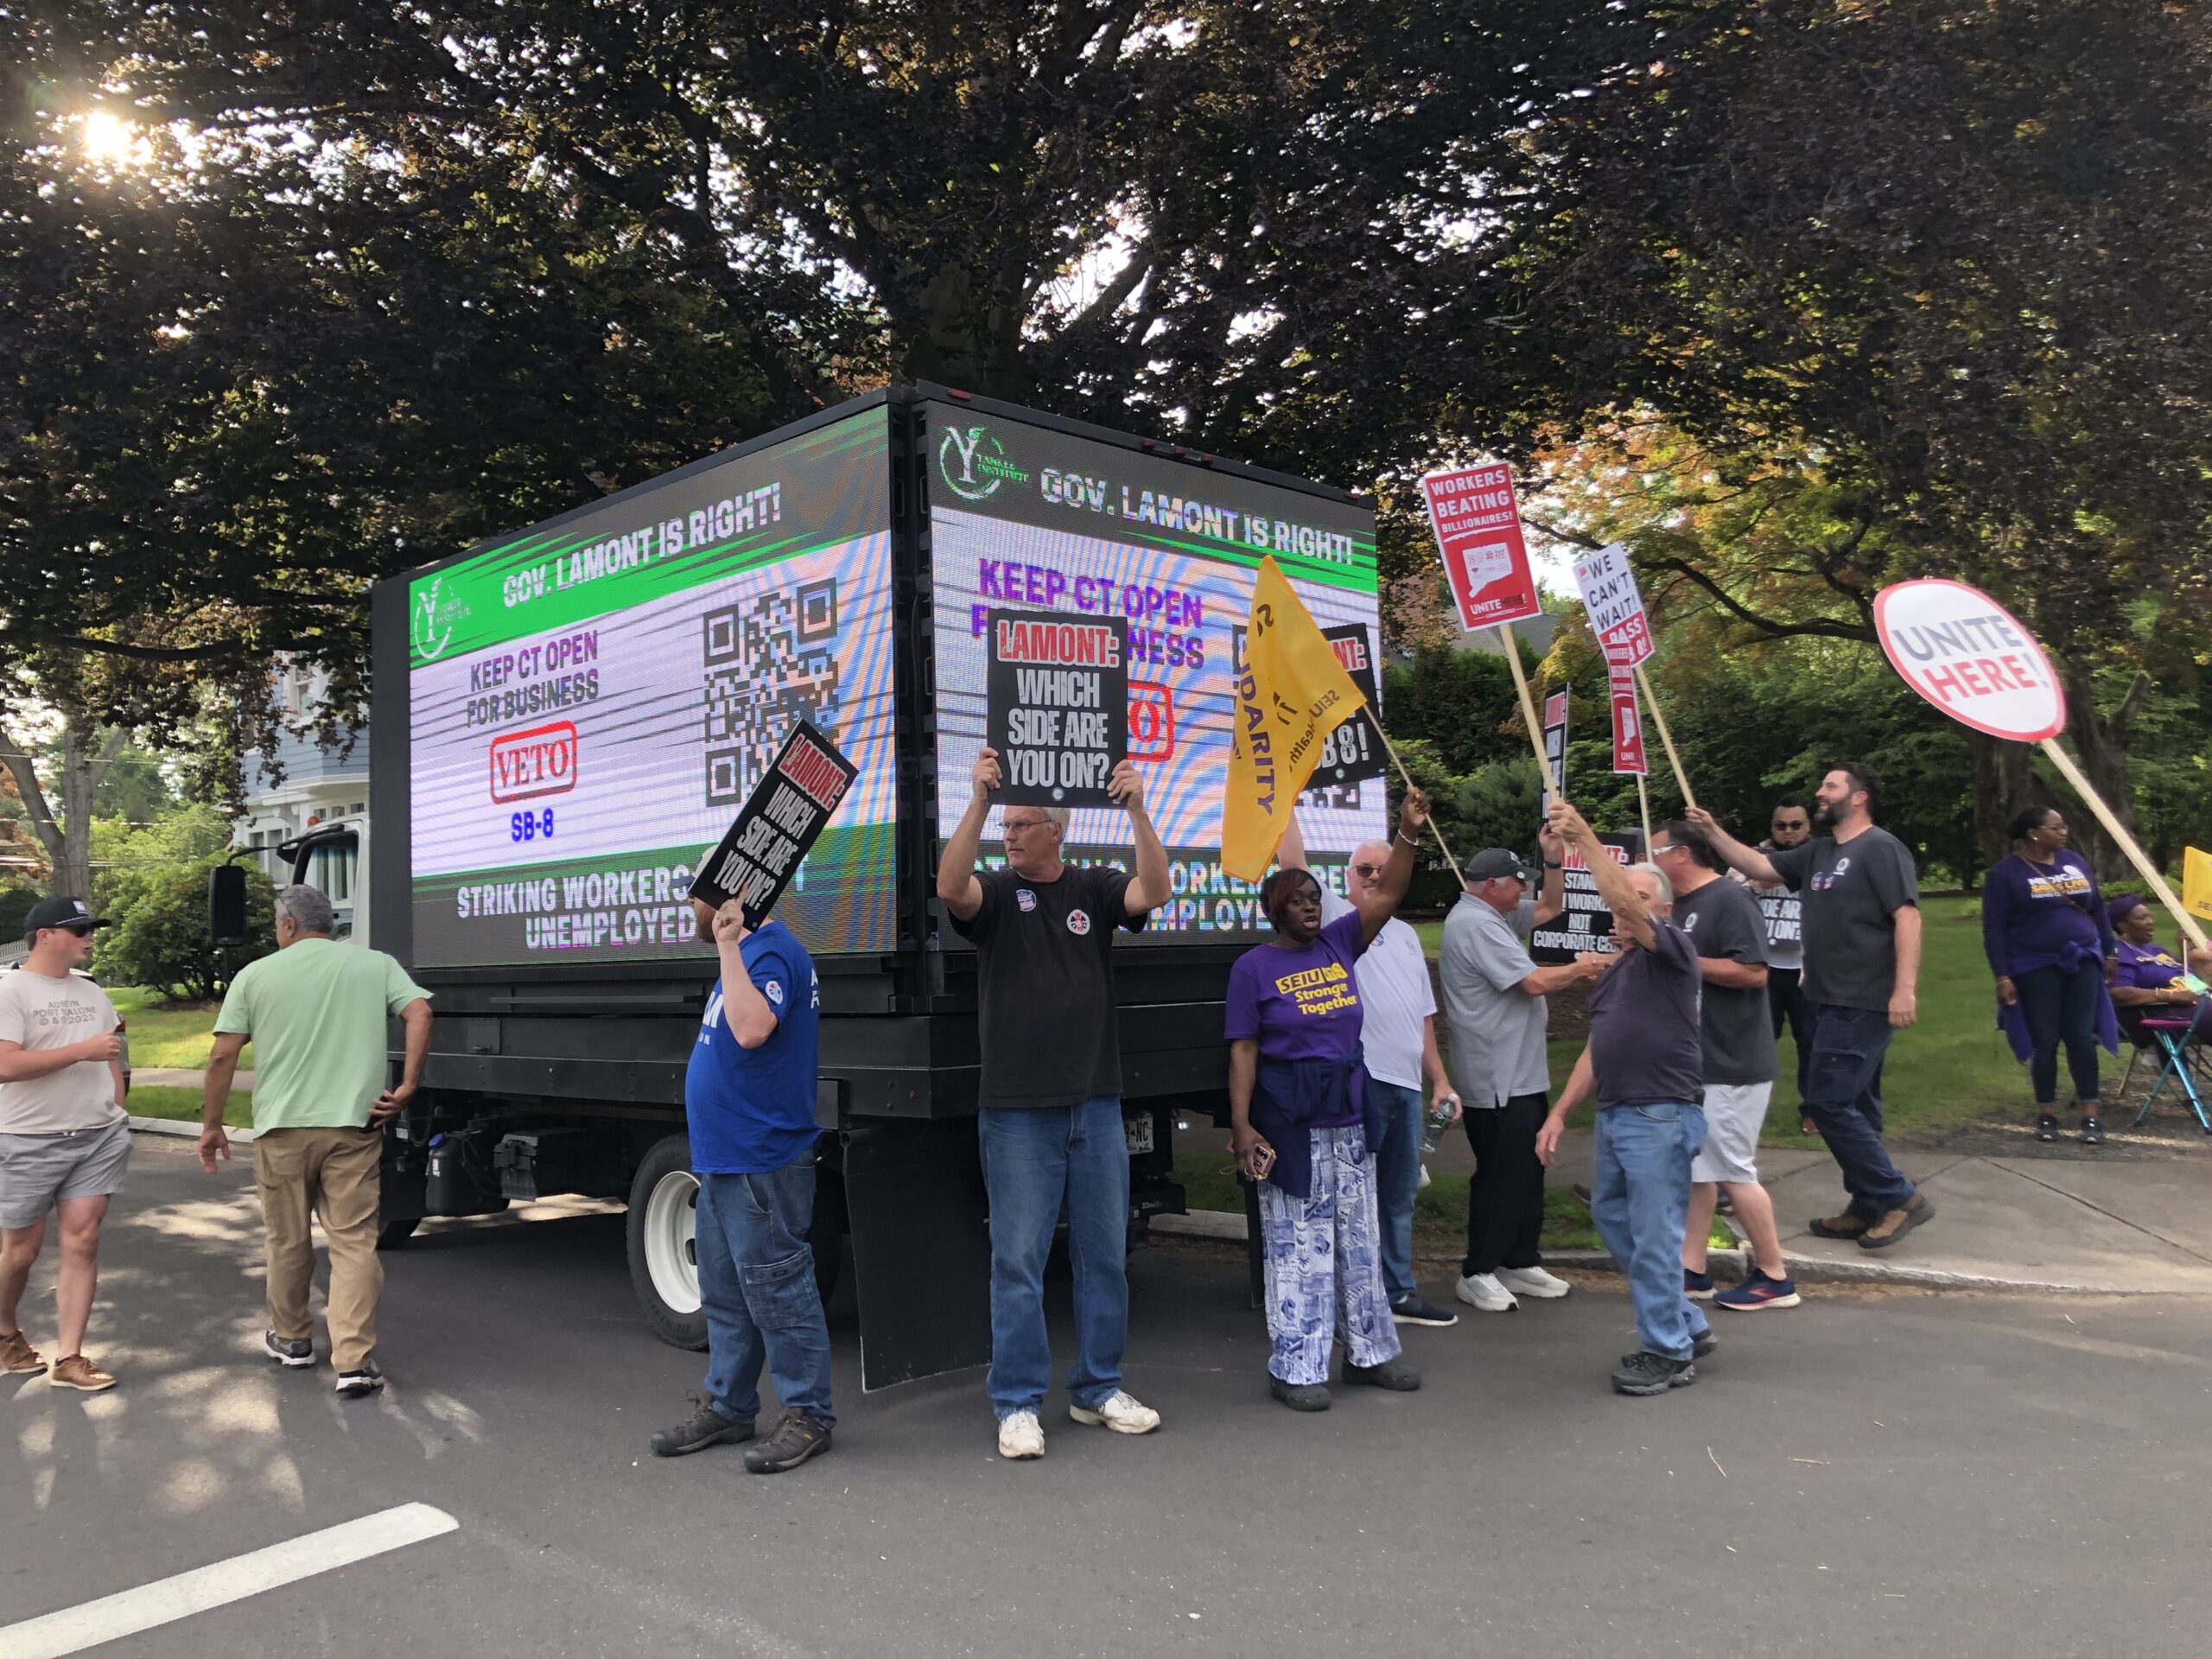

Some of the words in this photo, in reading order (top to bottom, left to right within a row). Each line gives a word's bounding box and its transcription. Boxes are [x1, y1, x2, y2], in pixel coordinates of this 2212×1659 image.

[1430, 469, 1505, 497] WORKERS
[1040, 467, 1114, 516] GOV.
[1122, 486, 1238, 541] LAMONT
[1244, 513, 1268, 547] IS
[1274, 520, 1352, 565] RIGHT!
[1435, 490, 1510, 518] BEATING
[1441, 511, 1514, 533] BILLIONAIRES!
[504, 564, 551, 607] GOV.
[556, 526, 652, 591] LAMONT
[659, 517, 683, 558] IS
[690, 482, 780, 549] RIGHT!
[1587, 554, 1612, 579] WE
[979, 557, 1066, 605] KEEP
[1075, 575, 1115, 614] CT
[1123, 583, 1203, 628] OPEN
[1470, 598, 1503, 614] UNITE
[1588, 571, 1629, 607] CAN'T
[1596, 594, 1637, 630] WAIT!
[997, 620, 1119, 668] LAMONT:
[1891, 614, 2024, 661] UNITE
[471, 654, 514, 691] KEEP
[518, 645, 542, 679] CT
[546, 630, 598, 671] OPEN
[1922, 652, 2050, 702] HERE!
[467, 694, 499, 728] FOR
[504, 668, 599, 720] BUSINESS
[1016, 668, 1100, 708] WHICH
[1008, 709, 1060, 747] SIDE
[1064, 712, 1109, 748] ARE
[1316, 722, 1370, 769] B8!
[496, 739, 569, 788] VETO
[778, 733, 847, 812] LAMONT:
[1007, 749, 1056, 787] YOU
[1060, 752, 1109, 789] ON?
[512, 808, 554, 842] SB-8
[764, 782, 817, 840] WHICH
[736, 816, 778, 862] SIDE
[765, 836, 798, 877] ARE
[457, 876, 556, 918] STRIKING
[713, 849, 753, 895] YOU
[744, 868, 776, 911] ON?
[1565, 873, 1596, 890] STAN
[525, 906, 696, 950] UNEMPLOYED
[1533, 931, 1597, 950] CORPORATE
[1568, 912, 1591, 931] NOT
[1281, 969, 1319, 992] SEIU
[33, 1008, 59, 1018] POST
[48, 1000, 79, 1008] AUSTIN
[1298, 995, 1357, 1014] Together
